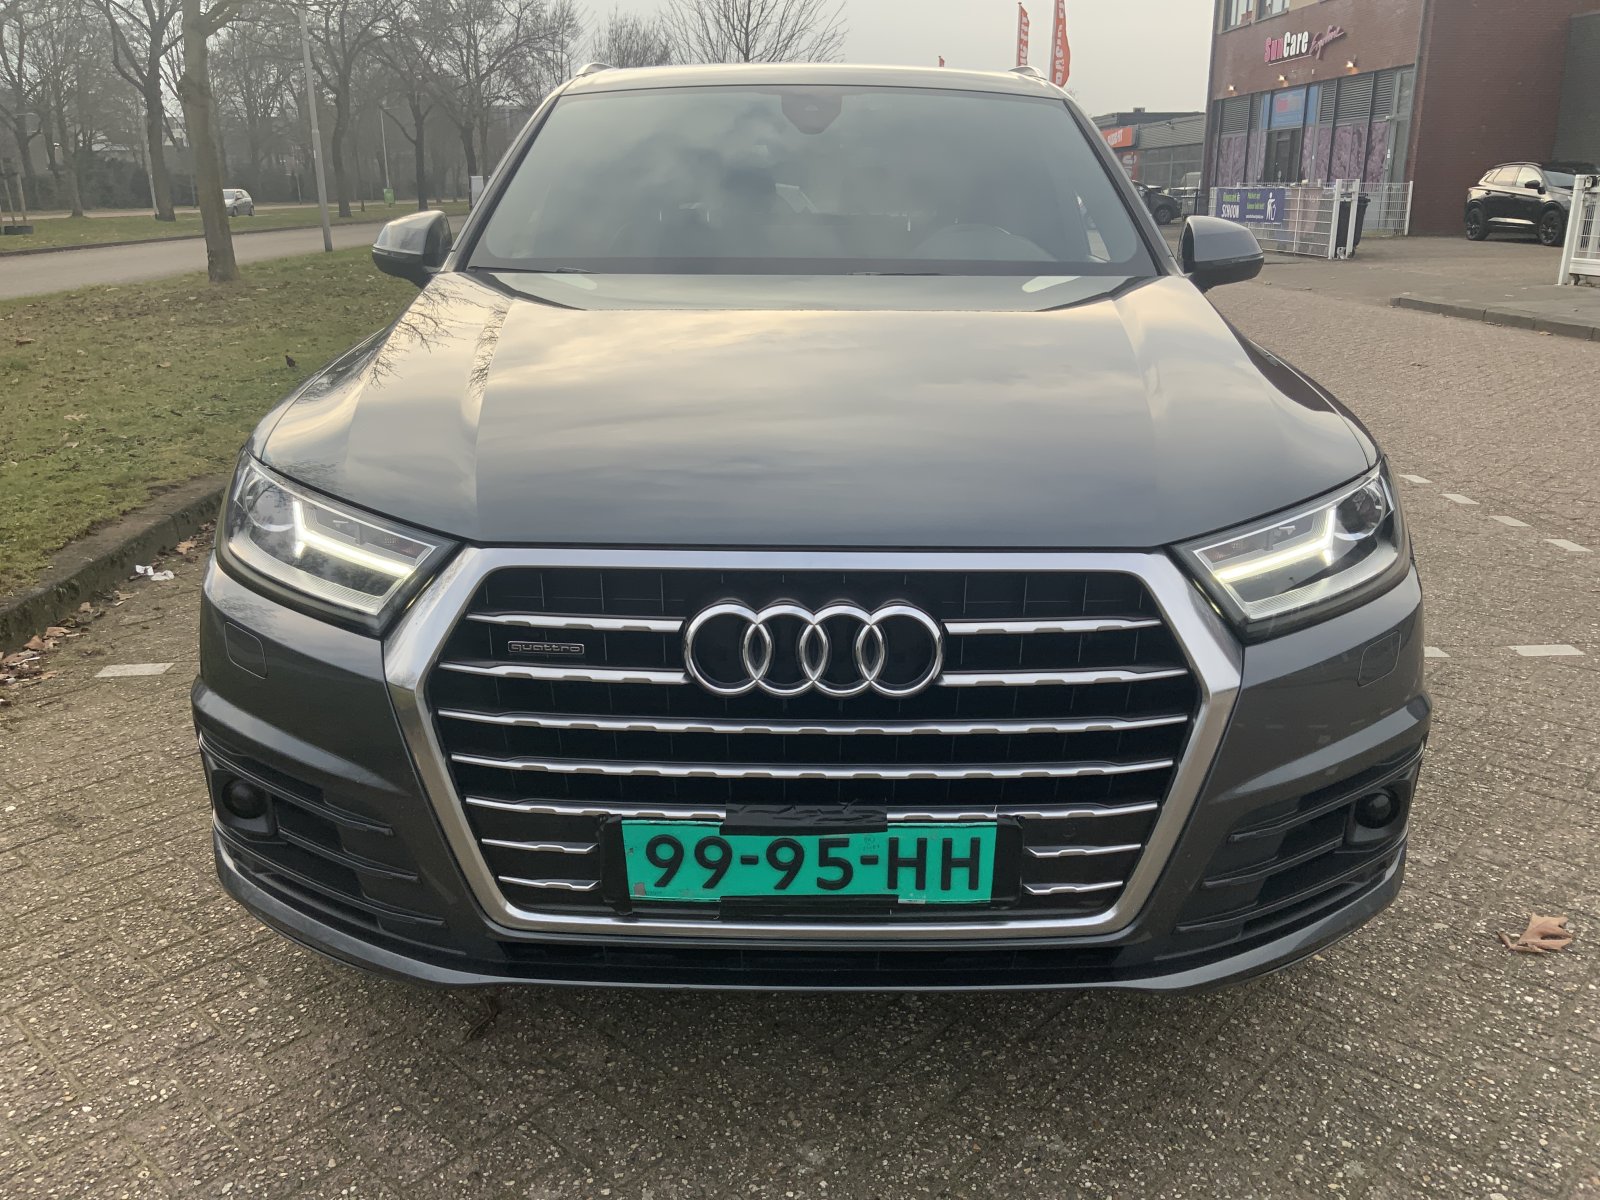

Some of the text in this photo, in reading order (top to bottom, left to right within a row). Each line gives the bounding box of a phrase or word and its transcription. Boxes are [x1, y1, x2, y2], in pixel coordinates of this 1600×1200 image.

[1264, 31, 1309, 63] SunCare
[511, 643, 581, 652] quattro
[645, 834, 980, 891] 99-95-HH
